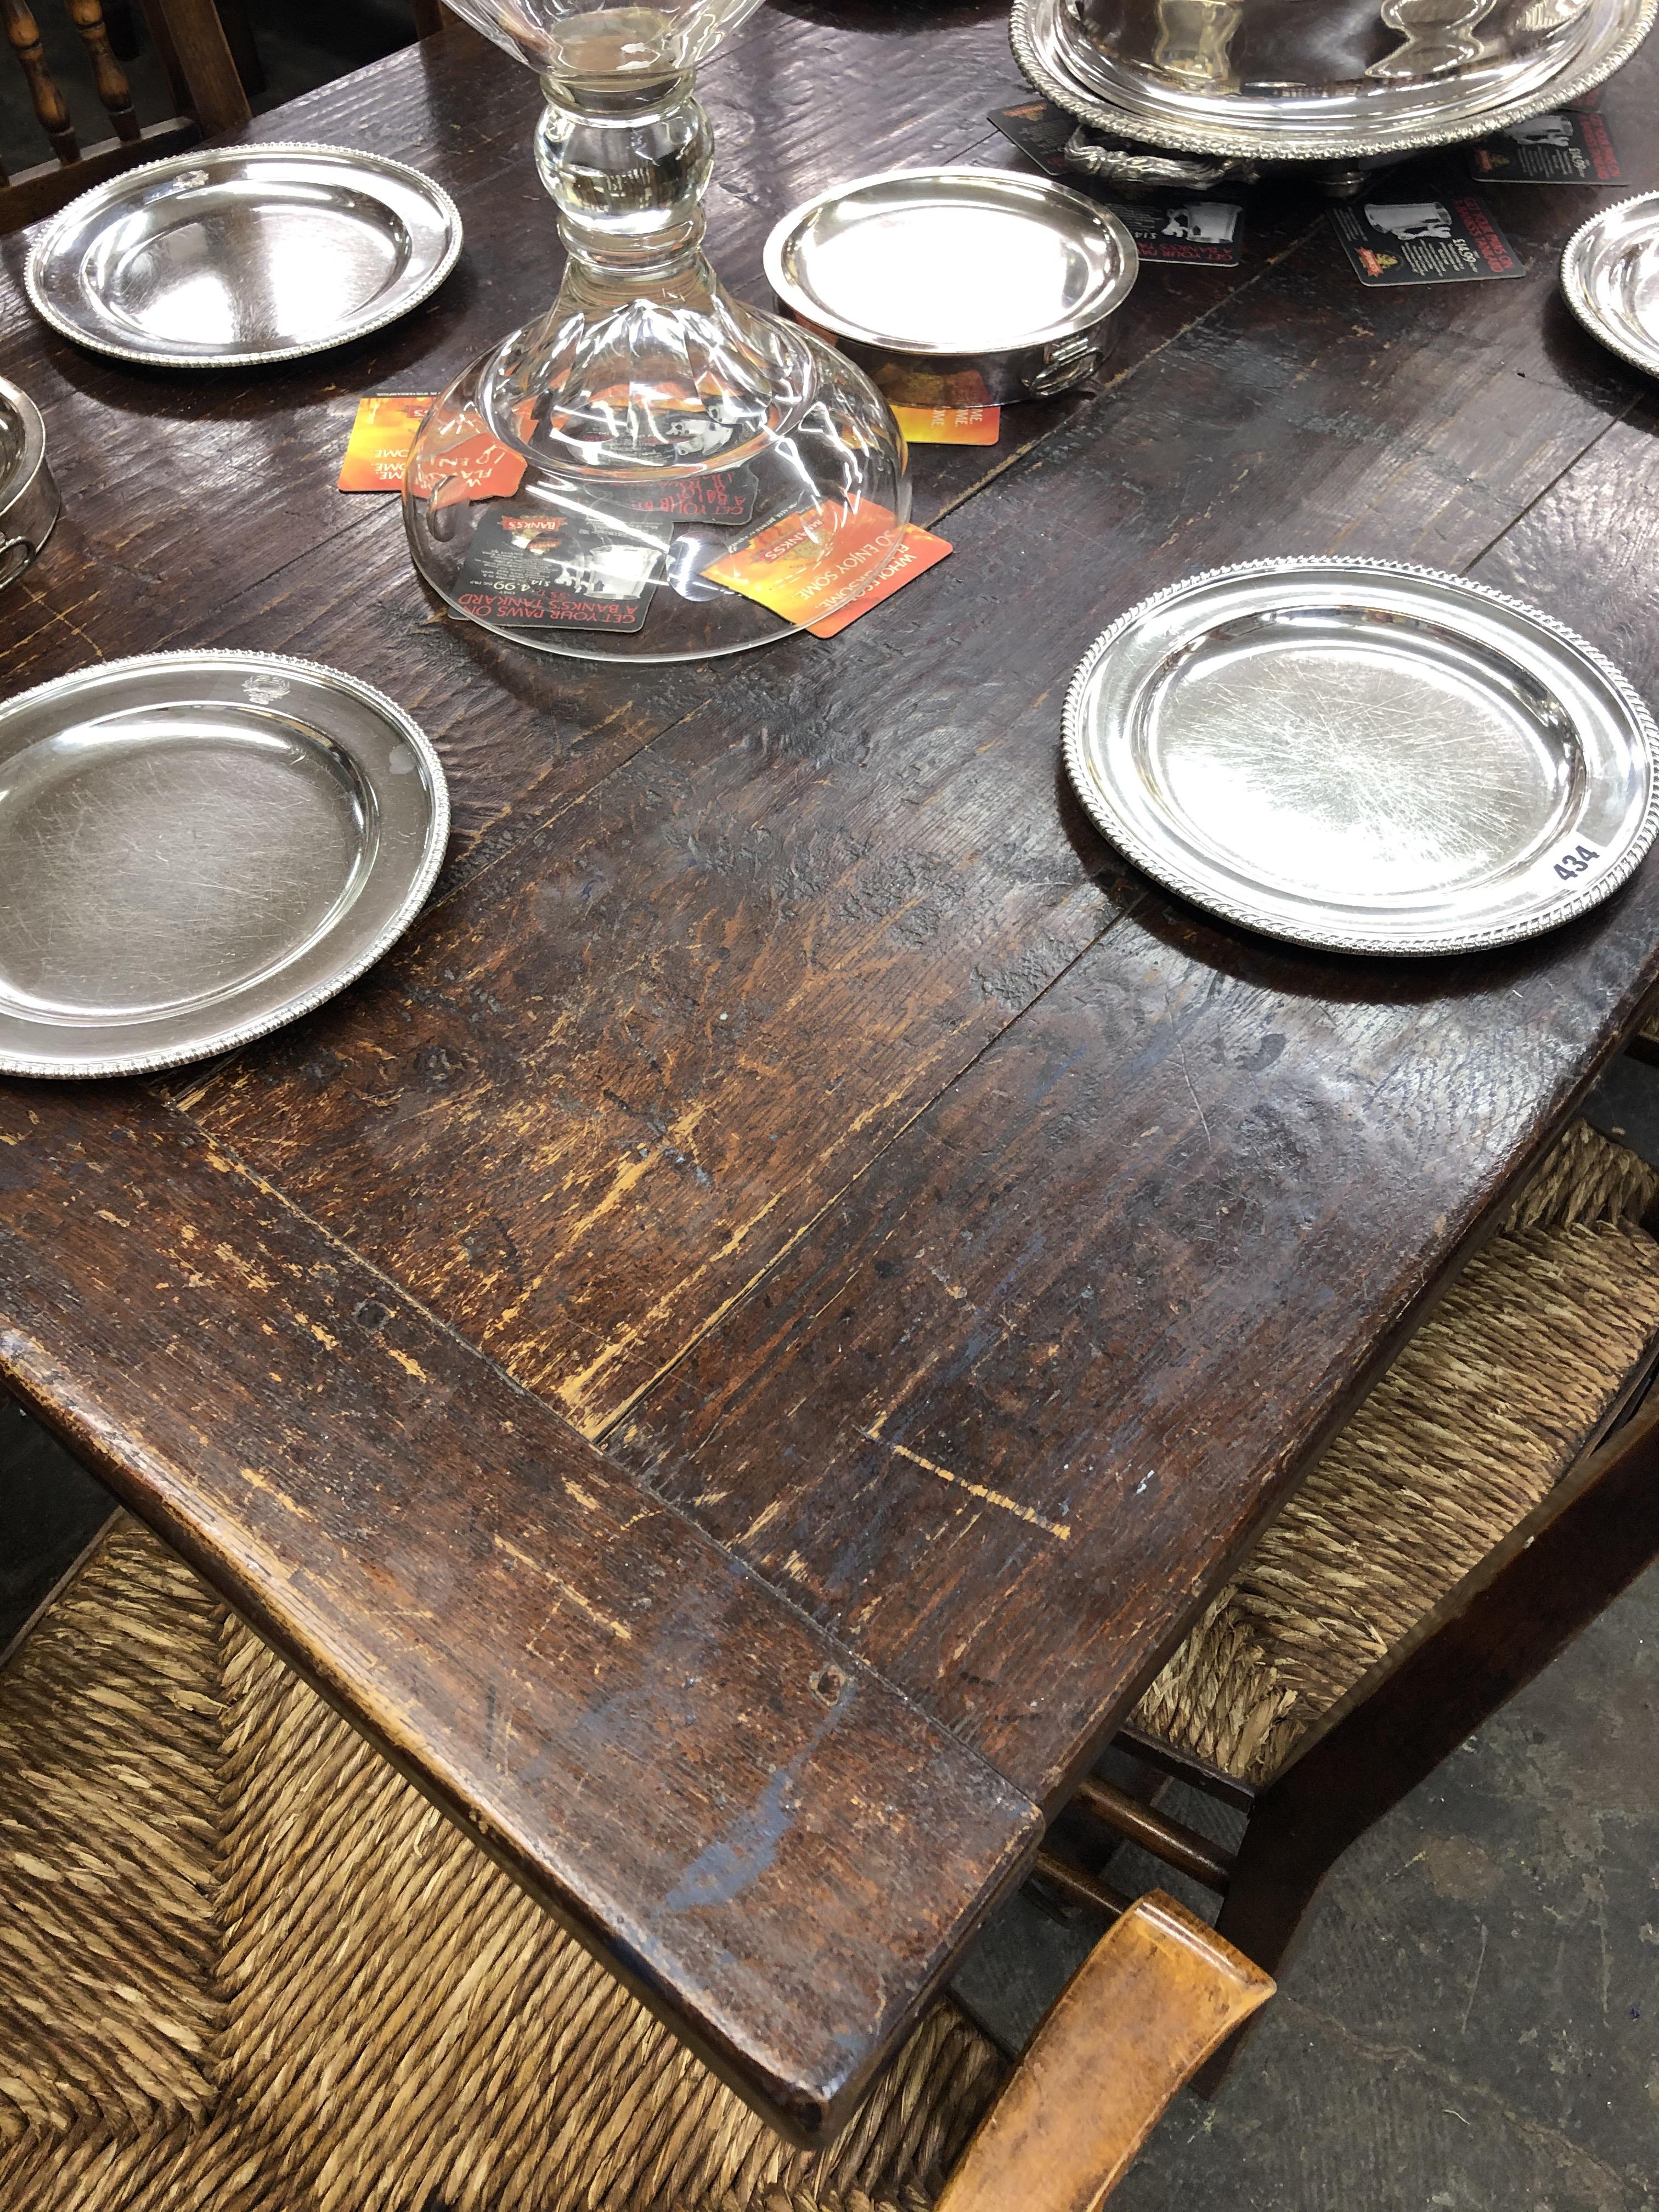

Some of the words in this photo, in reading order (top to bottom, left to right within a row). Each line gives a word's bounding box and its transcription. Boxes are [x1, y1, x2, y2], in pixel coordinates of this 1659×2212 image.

[509, 521, 556, 530] BANKS'S
[836, 543, 879, 574] ENJOY
[458, 593, 543, 607] TANKARD
[497, 606, 544, 619] PAWS
[549, 600, 620, 614] BANKS'S
[625, 605, 639, 615] A
[550, 609, 597, 622] YOUR
[605, 613, 636, 624] GET
[1553, 845, 1600, 881] 434
